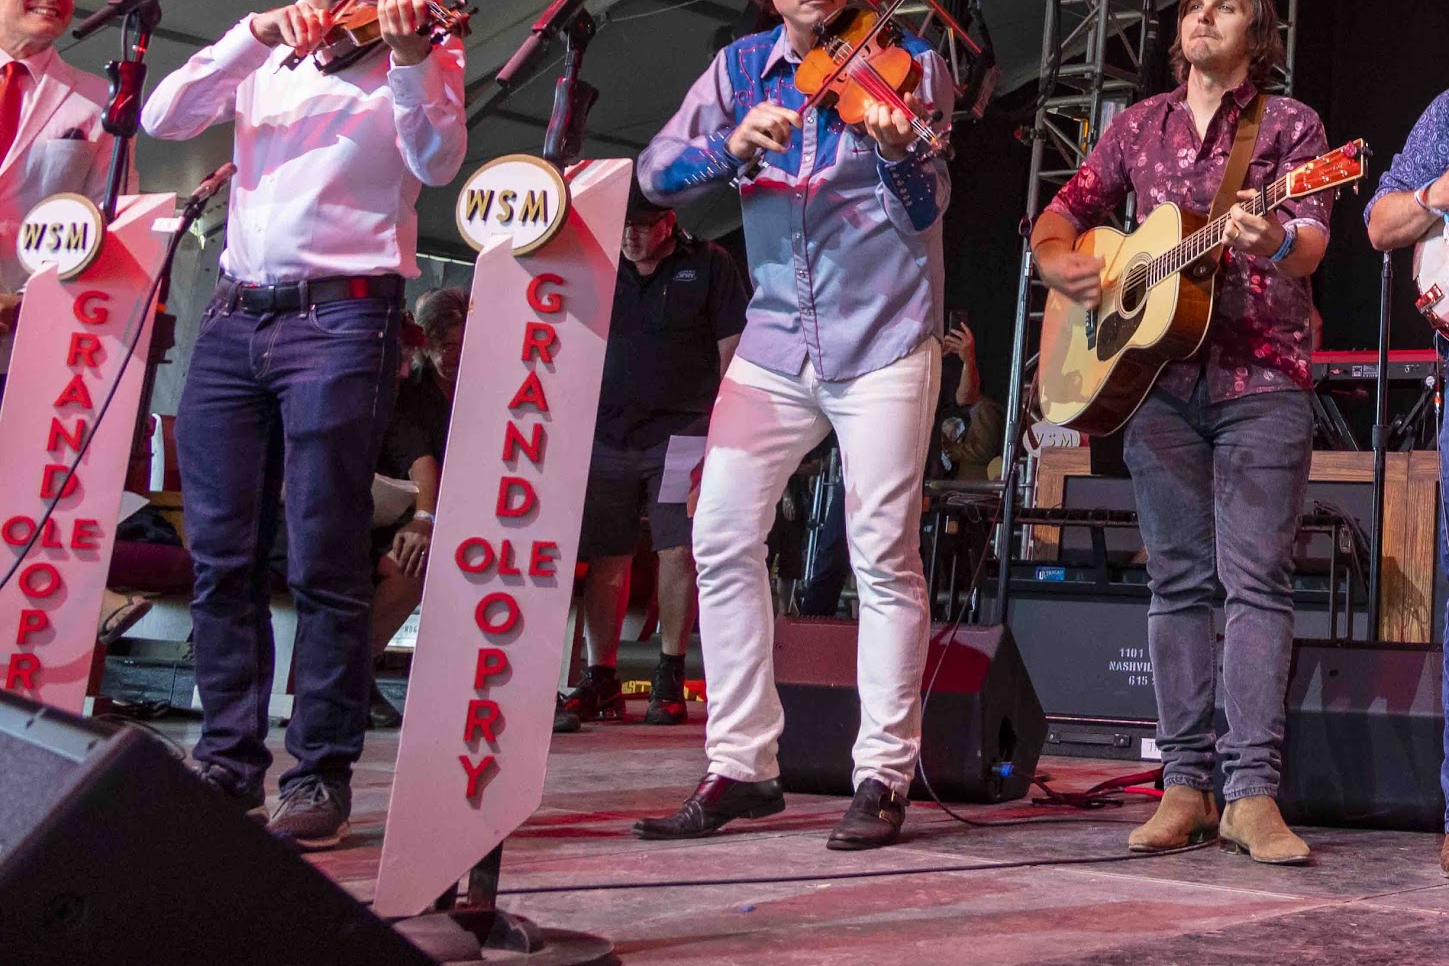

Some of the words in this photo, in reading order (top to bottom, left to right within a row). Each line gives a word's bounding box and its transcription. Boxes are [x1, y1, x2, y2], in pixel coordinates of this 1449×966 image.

[466, 189, 549, 224] WSM
[24, 222, 88, 251] WSM
[40, 290, 109, 499] GRAND
[495, 273, 565, 518] GRAND
[2, 515, 98, 549] OLE
[455, 537, 557, 577] OLE
[6, 562, 62, 690] OPR
[1108, 660, 1153, 673] NASHVIL
[1119, 647, 1144, 658] 1101
[459, 592, 520, 799] OPRY
[1128, 675, 1148, 686] 615
